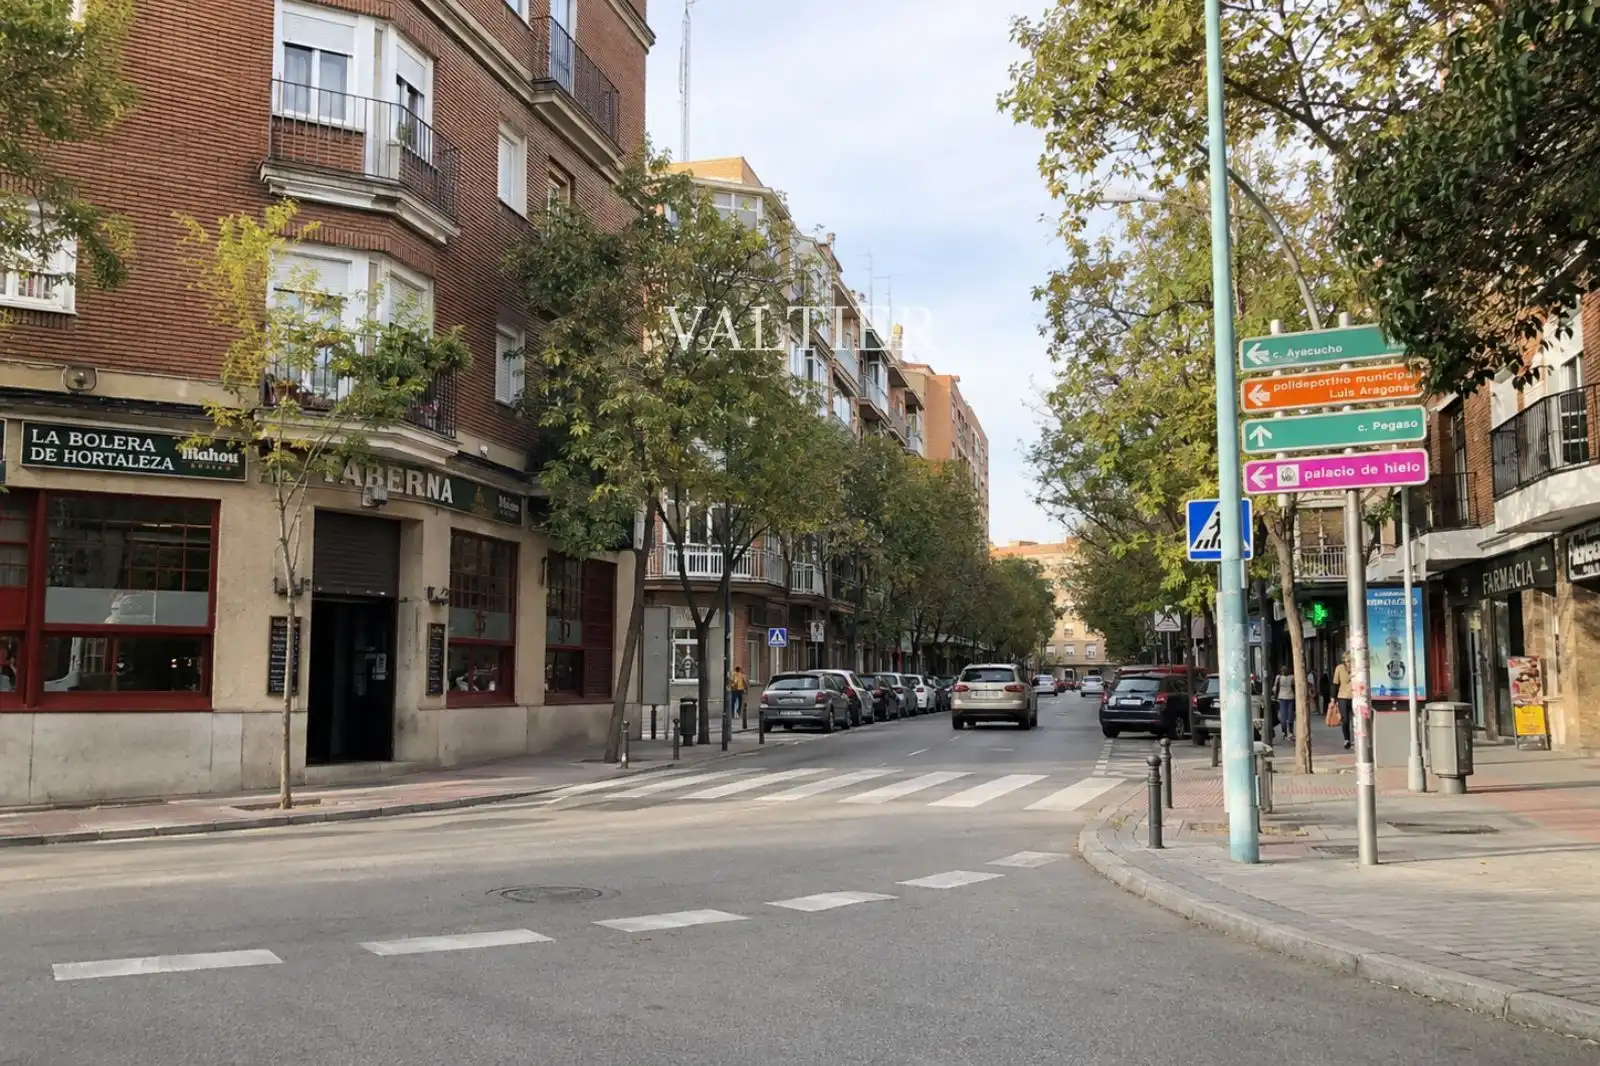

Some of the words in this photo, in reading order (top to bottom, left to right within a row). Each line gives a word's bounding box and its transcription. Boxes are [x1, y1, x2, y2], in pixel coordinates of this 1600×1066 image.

[1272, 351, 1284, 359] c.
[1286, 344, 1343, 358] Ayacucho
[1330, 389, 1355, 398] Luis
[1358, 424, 1368, 432] c.
[1373, 420, 1418, 432] Pegaso
[31, 428, 60, 445] LA
[68, 431, 156, 452] BOLERA
[30, 446, 57, 462] DE
[63, 449, 175, 471] HORTALEZA
[182, 447, 239, 464] Mahou
[1304, 466, 1356, 482] palacio
[1361, 464, 1378, 475] de
[1385, 462, 1421, 474] hielo
[1482, 560, 1535, 596] FARMACIA
